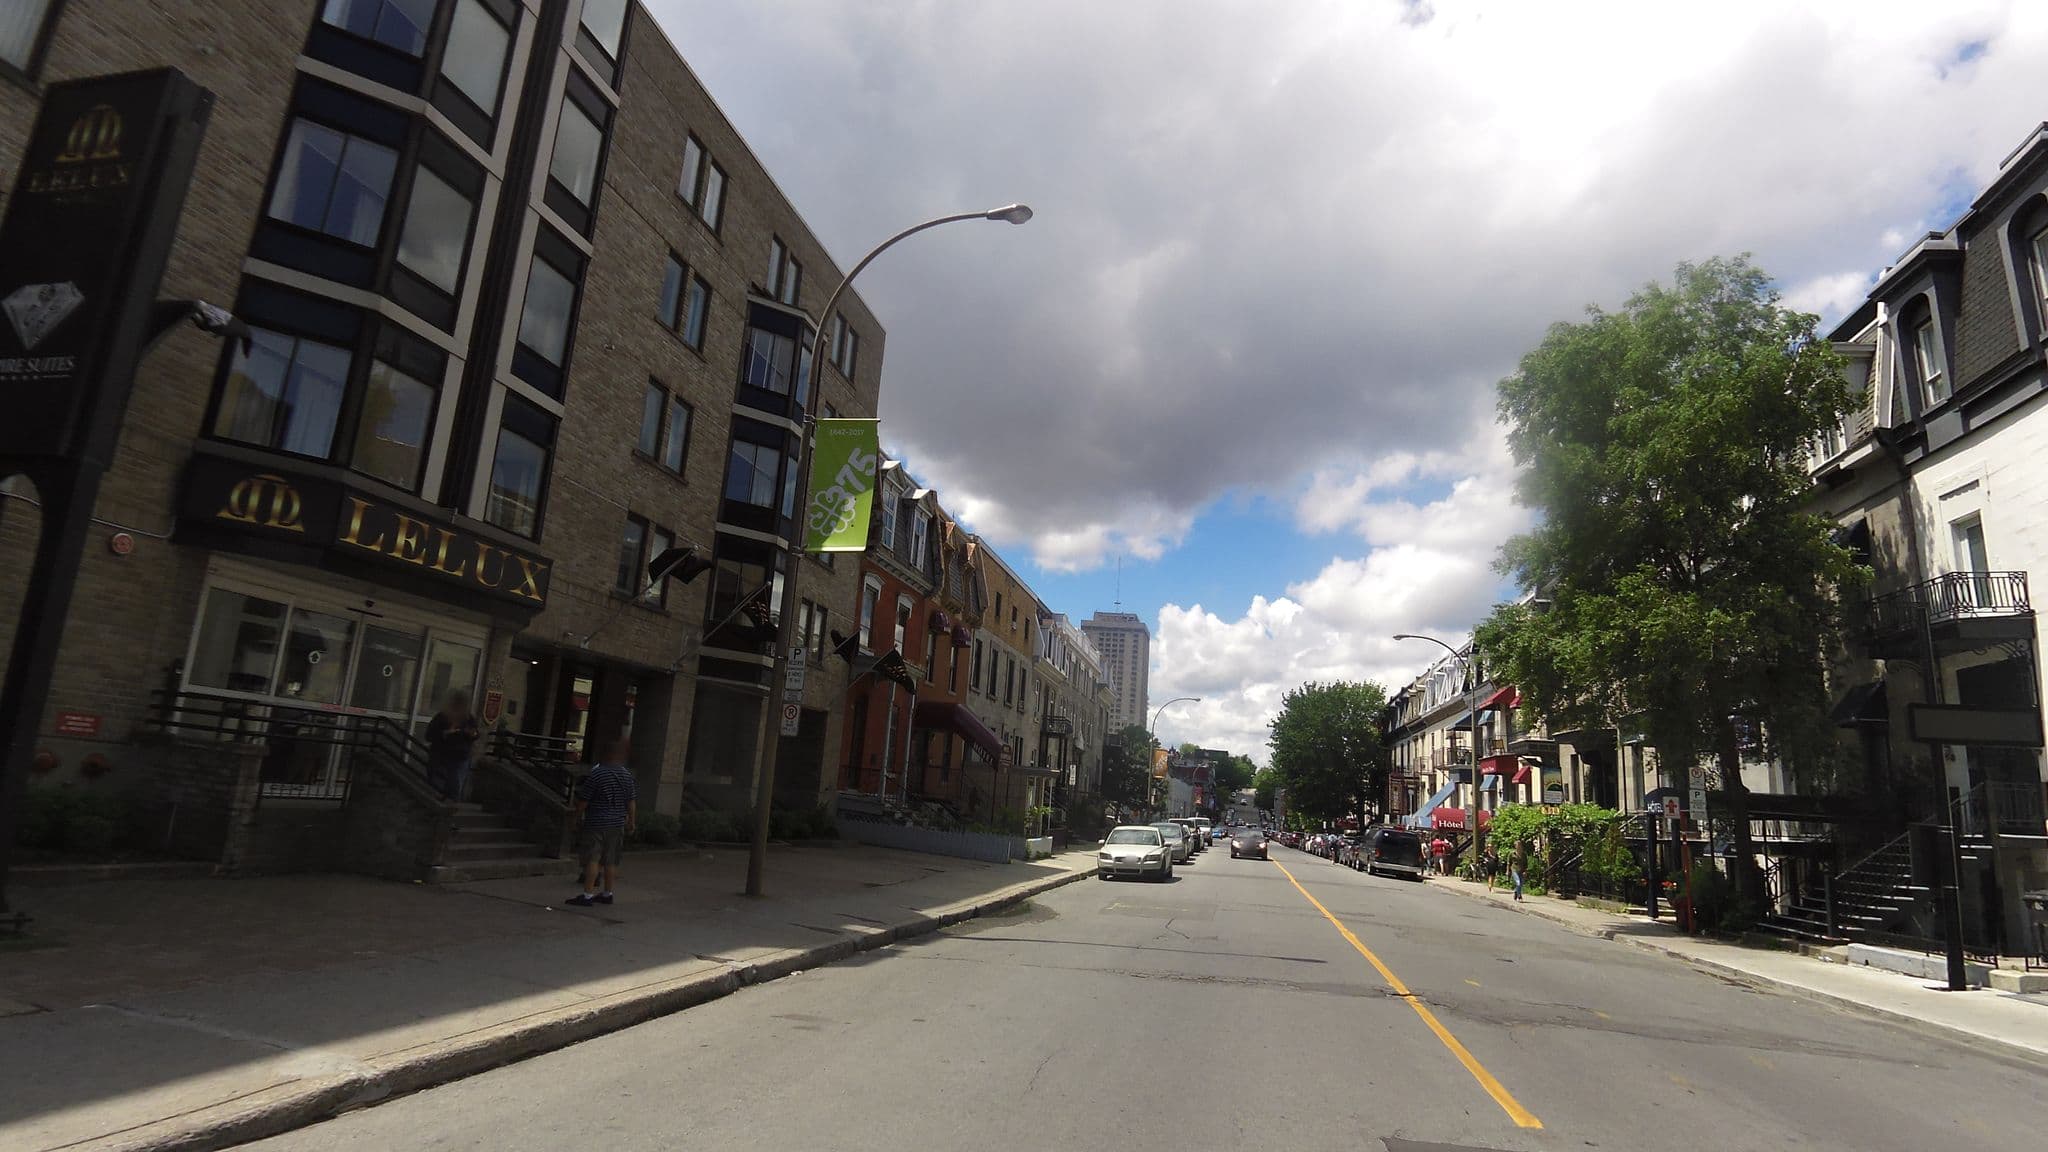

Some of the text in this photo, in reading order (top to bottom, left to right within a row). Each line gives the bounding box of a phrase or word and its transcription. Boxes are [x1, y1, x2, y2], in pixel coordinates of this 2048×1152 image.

[825, 447, 876, 513] 375
[338, 496, 547, 602] LELUX
[793, 648, 802, 660] P
[1438, 819, 1464, 829] Hôtel
